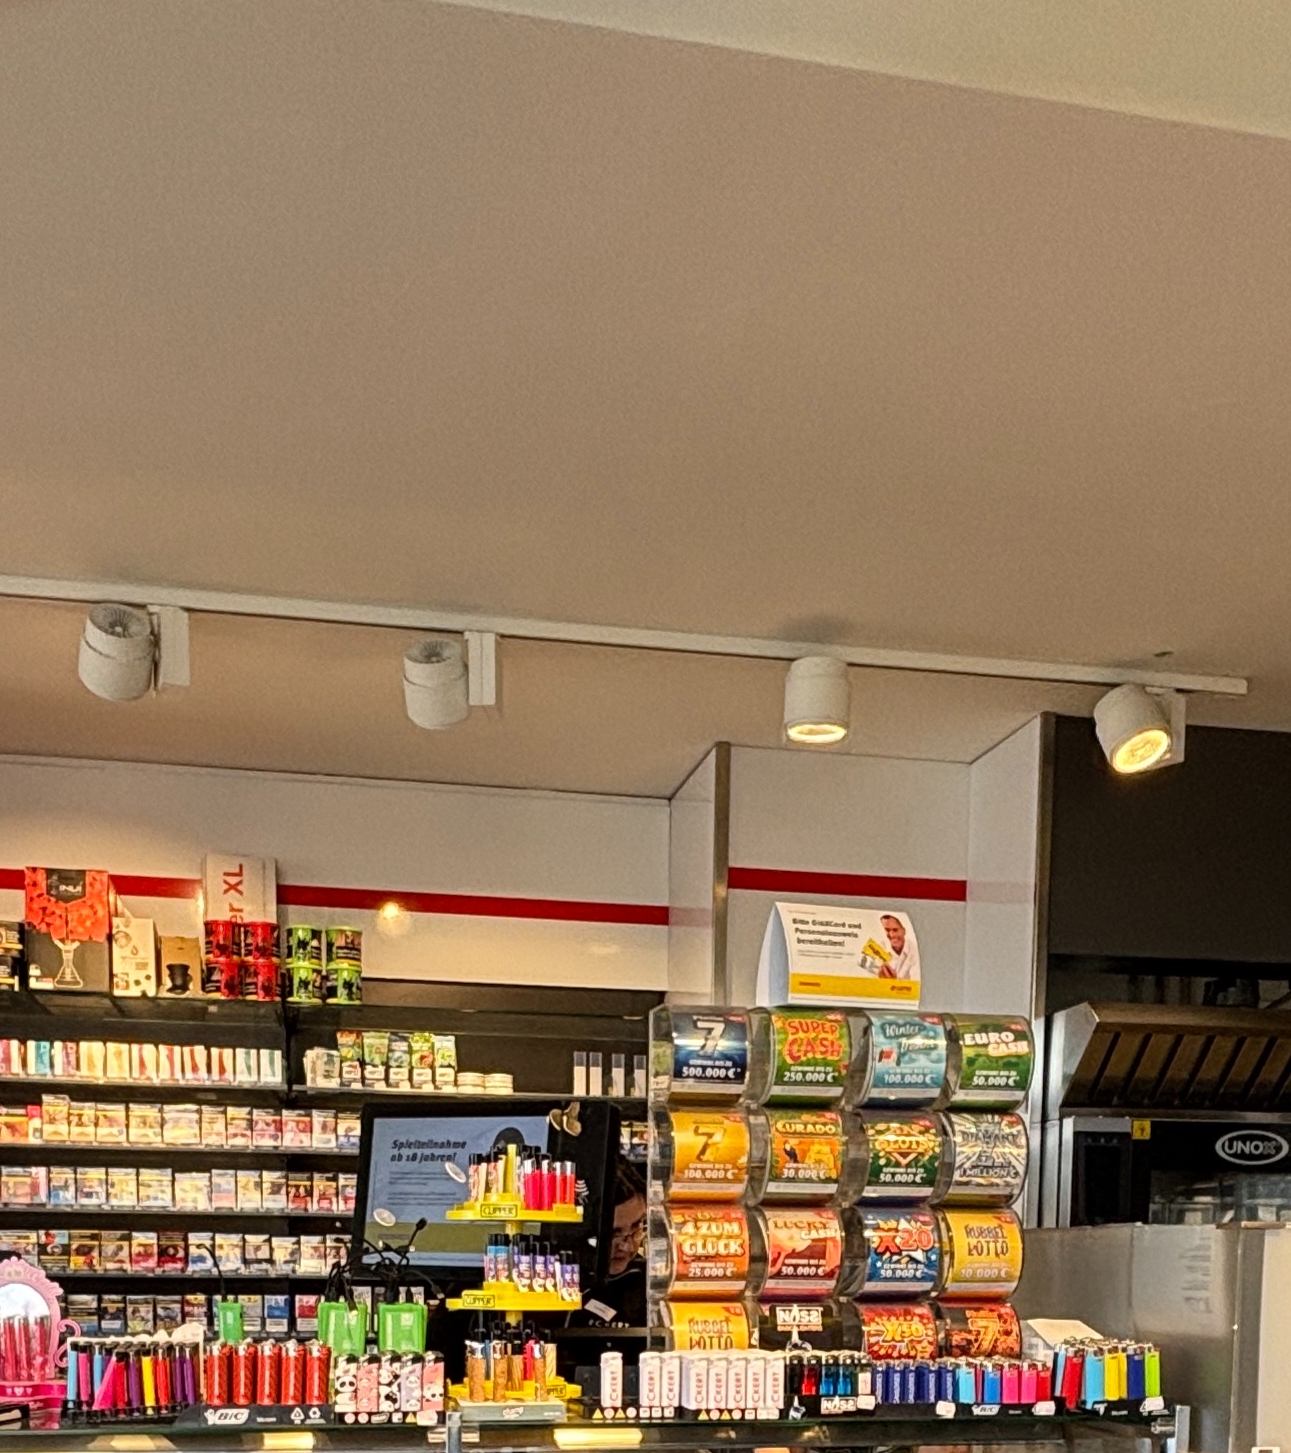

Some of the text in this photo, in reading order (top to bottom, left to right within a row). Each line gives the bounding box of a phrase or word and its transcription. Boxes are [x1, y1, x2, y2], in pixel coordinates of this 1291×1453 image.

[223, 863, 245, 897] XL
[786, 1019, 839, 1036] SUPER
[963, 1031, 1015, 1046] EURO
[682, 1067, 727, 1078] 500.000
[783, 1072, 825, 1082] 250.000
[392, 1139, 467, 1151] Spielteilnahme
[1224, 1140, 1278, 1155] UNOX
[390, 1152, 403, 1162] ab
[879, 1173, 913, 1183] 50.000
[482, 1206, 516, 1217] CLIPPER
[688, 1267, 724, 1277] 25.000
[217, 1412, 245, 1424] BIC
